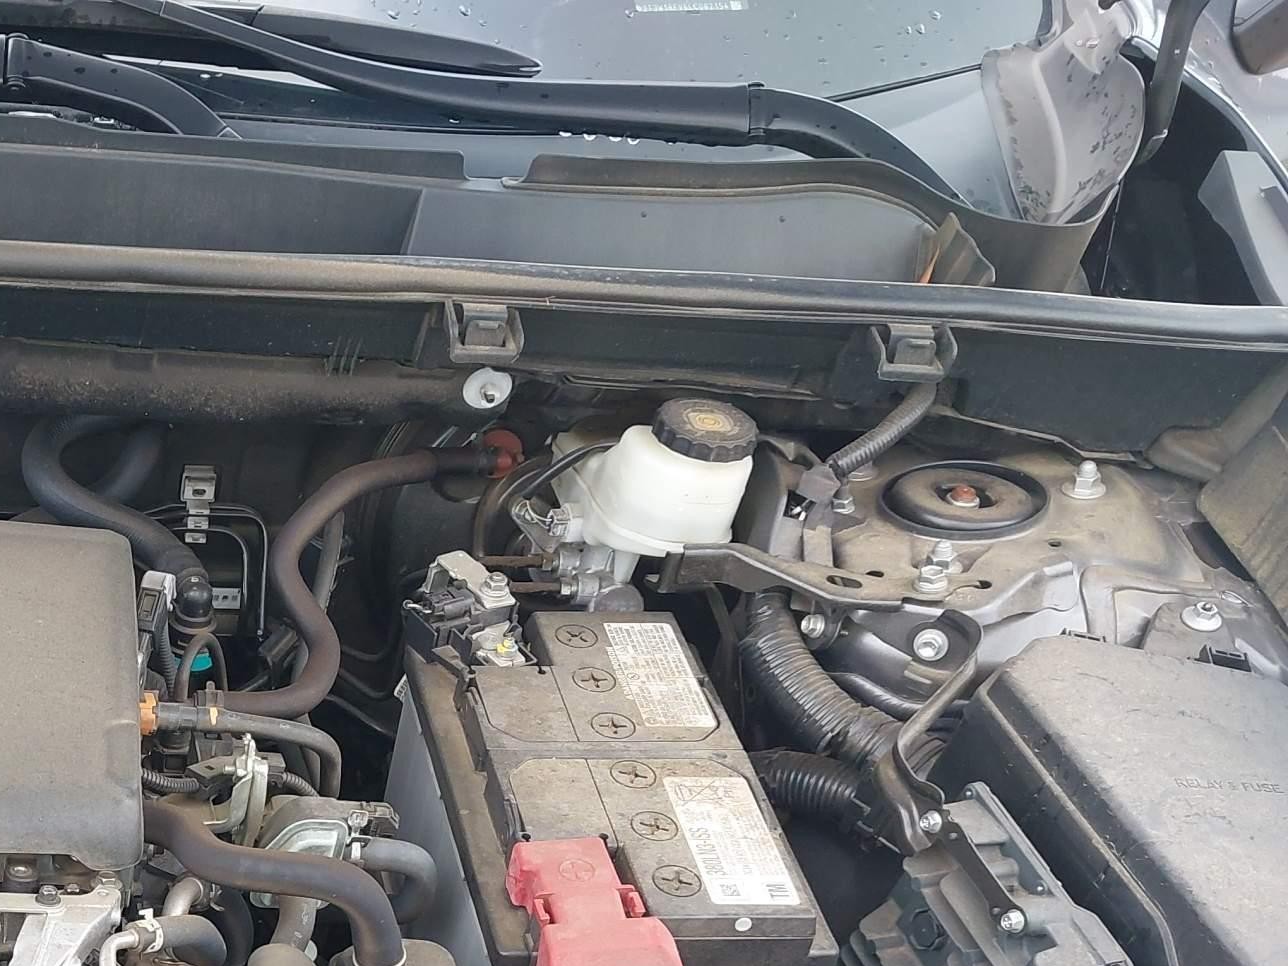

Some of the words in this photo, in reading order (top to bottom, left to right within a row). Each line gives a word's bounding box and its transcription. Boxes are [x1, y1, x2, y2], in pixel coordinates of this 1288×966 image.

[1174, 777, 1223, 790] RELAY
[1241, 781, 1285, 793] FUSE
[688, 826, 728, 876] 380LN3-ISS
[765, 883, 791, 900] TM
